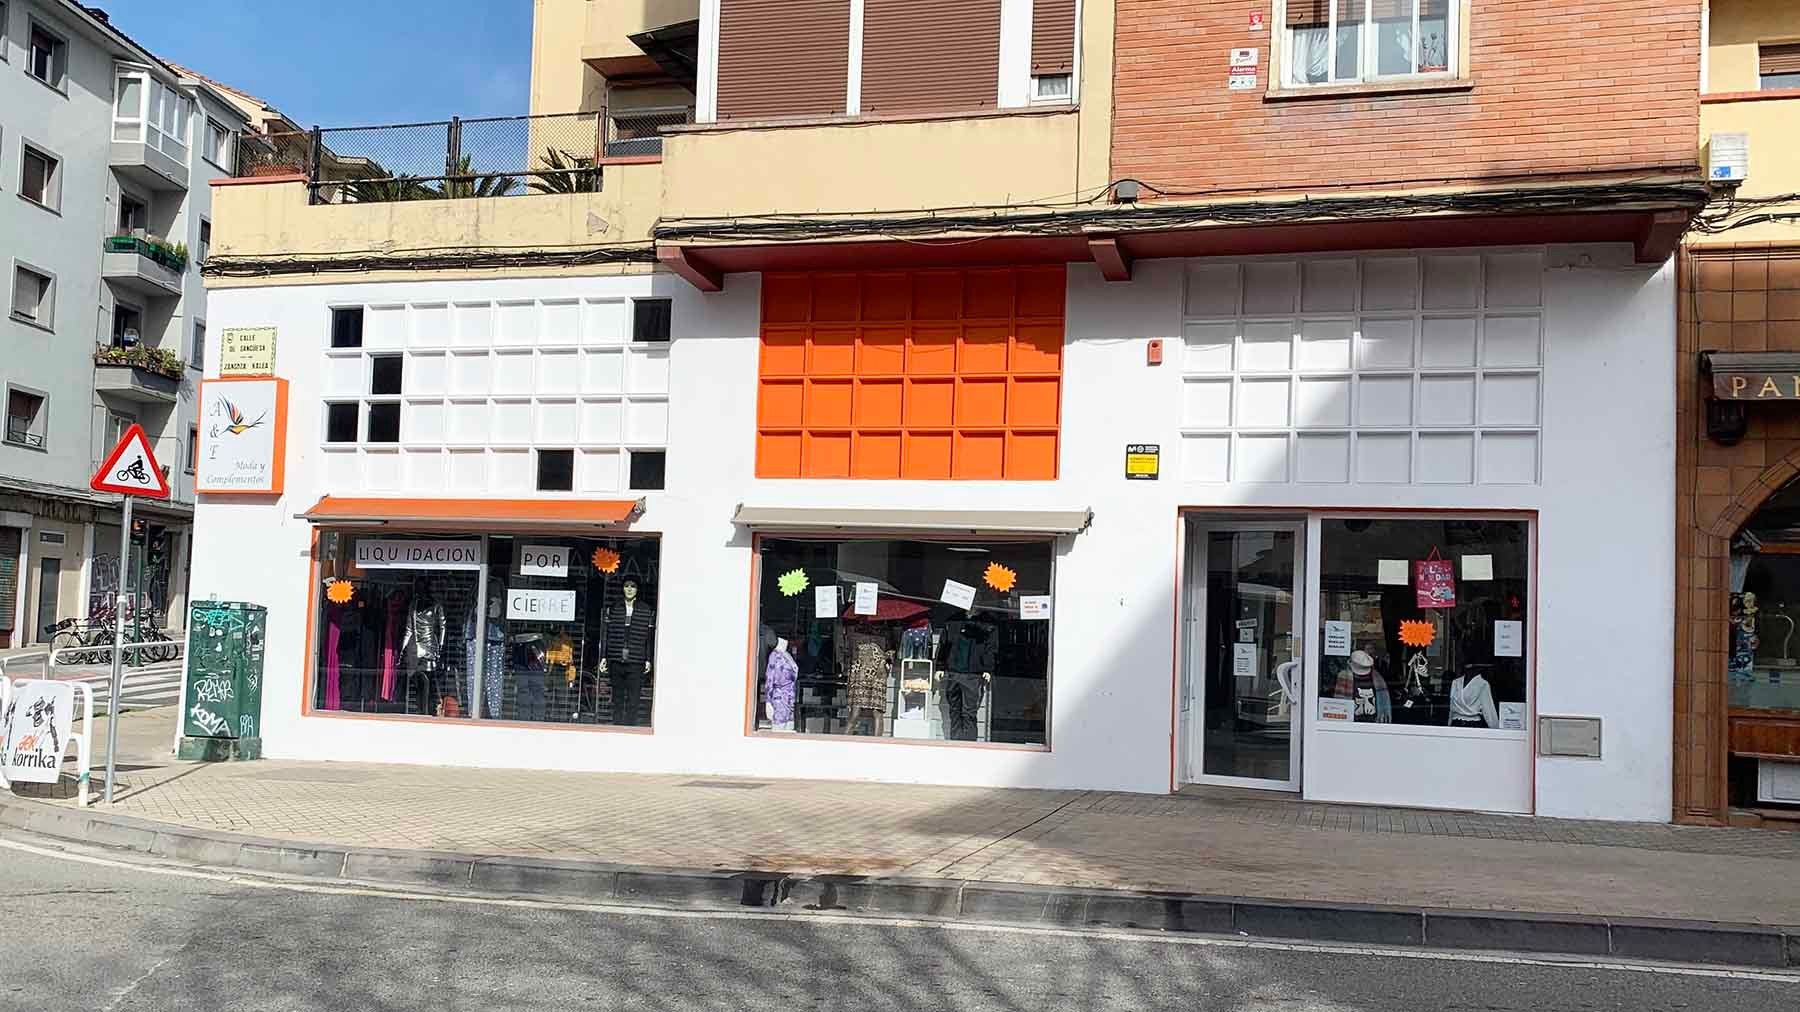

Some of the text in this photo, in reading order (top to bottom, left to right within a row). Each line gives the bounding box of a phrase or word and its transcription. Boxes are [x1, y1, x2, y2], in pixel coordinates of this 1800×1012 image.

[209, 400, 221, 417] A
[210, 424, 220, 438] &
[235, 460, 258, 471] Moda
[206, 473, 265, 484] Complementos
[523, 553, 562, 568] POR
[12, 747, 56, 768] korrika
